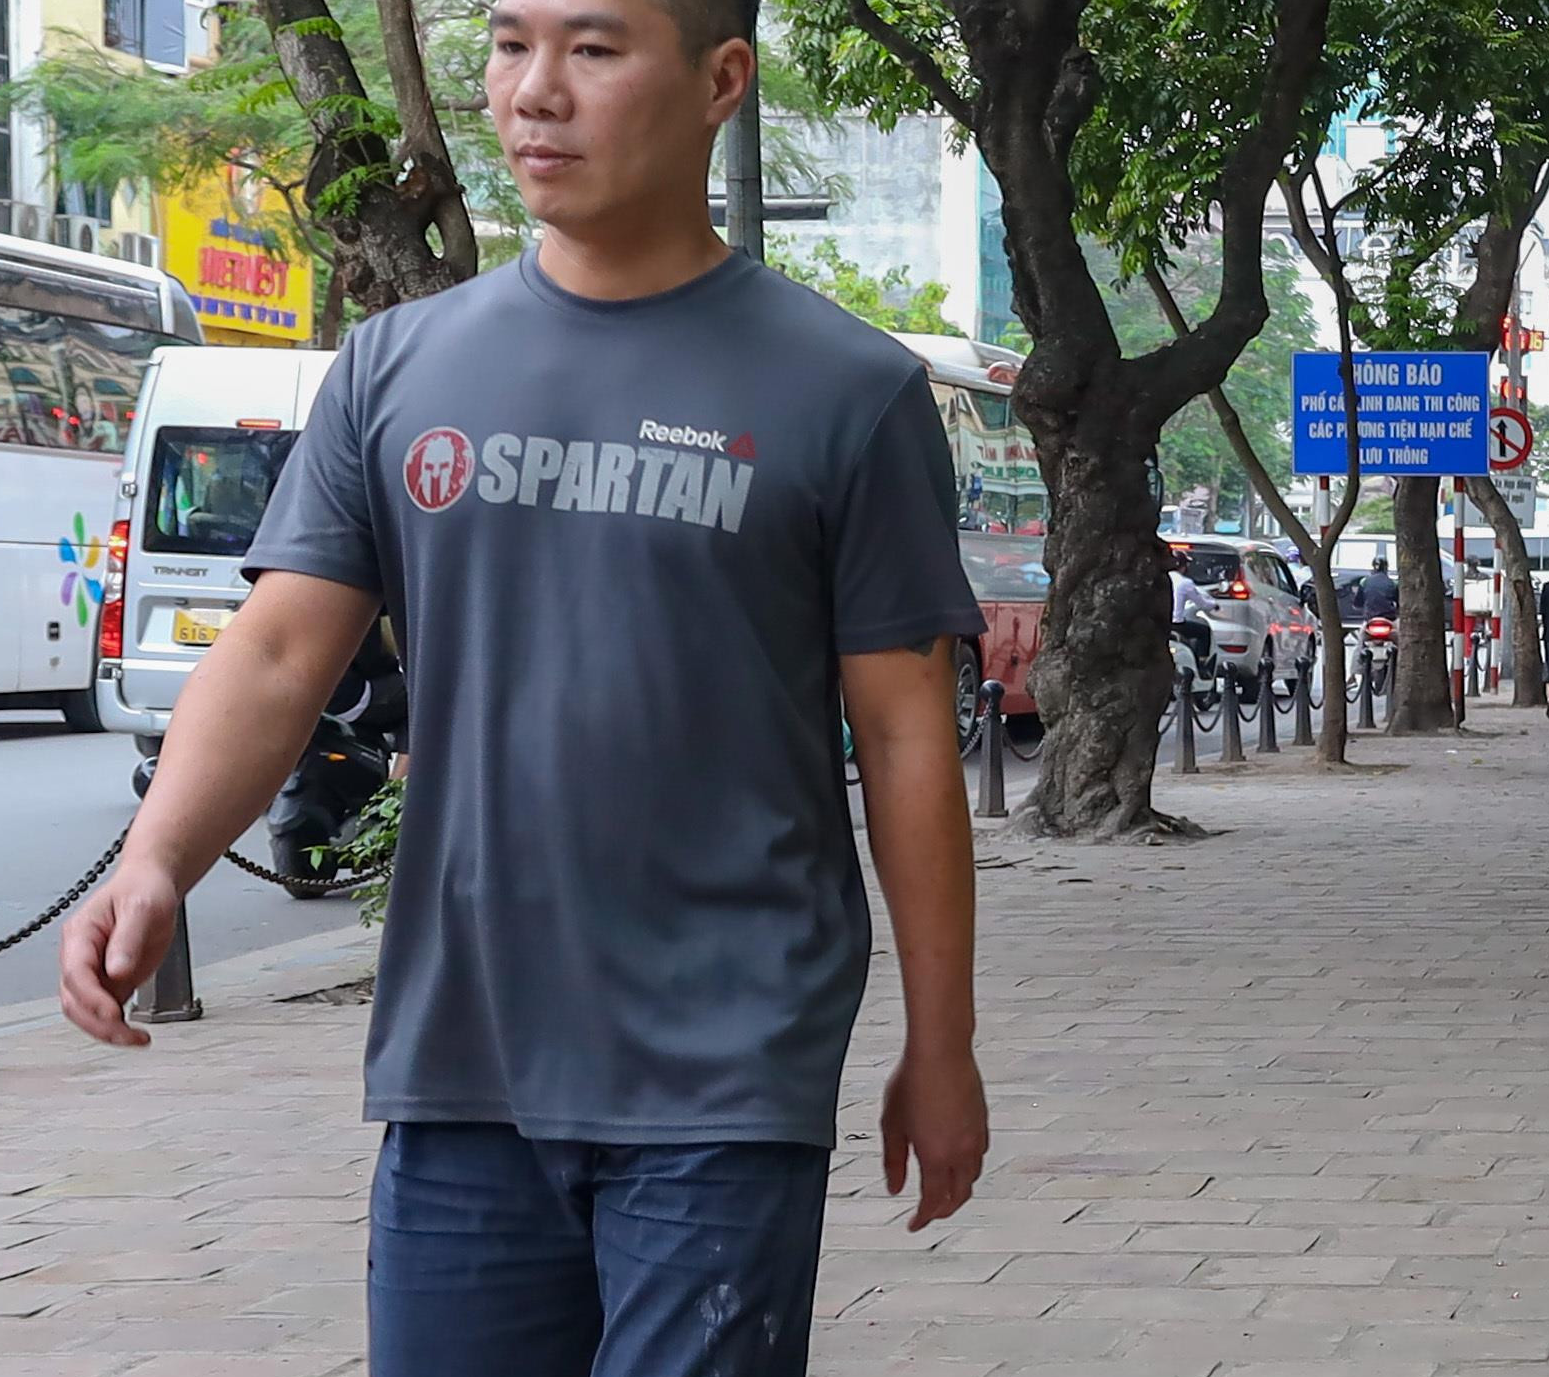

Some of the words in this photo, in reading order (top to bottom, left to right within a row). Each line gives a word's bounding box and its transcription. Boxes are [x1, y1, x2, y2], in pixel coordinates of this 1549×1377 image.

[1353, 358, 1400, 386] HÔNG
[1406, 359, 1442, 386] BÁO
[1301, 390, 1326, 412] PHỐ
[1328, 390, 1345, 412] CÁ
[1424, 395, 1443, 412] THI
[1446, 392, 1481, 412] CÔNG
[638, 418, 728, 454] Reebok
[1309, 418, 1334, 439] CÁC
[1389, 418, 1417, 442] TIỆN
[1419, 421, 1446, 442] HẠN
[1448, 417, 1474, 439] CHẾ
[1388, 445, 1429, 465] THÔNG
[477, 432, 755, 534] SPARTAN
[153, 565, 210, 577] TRANSIT
